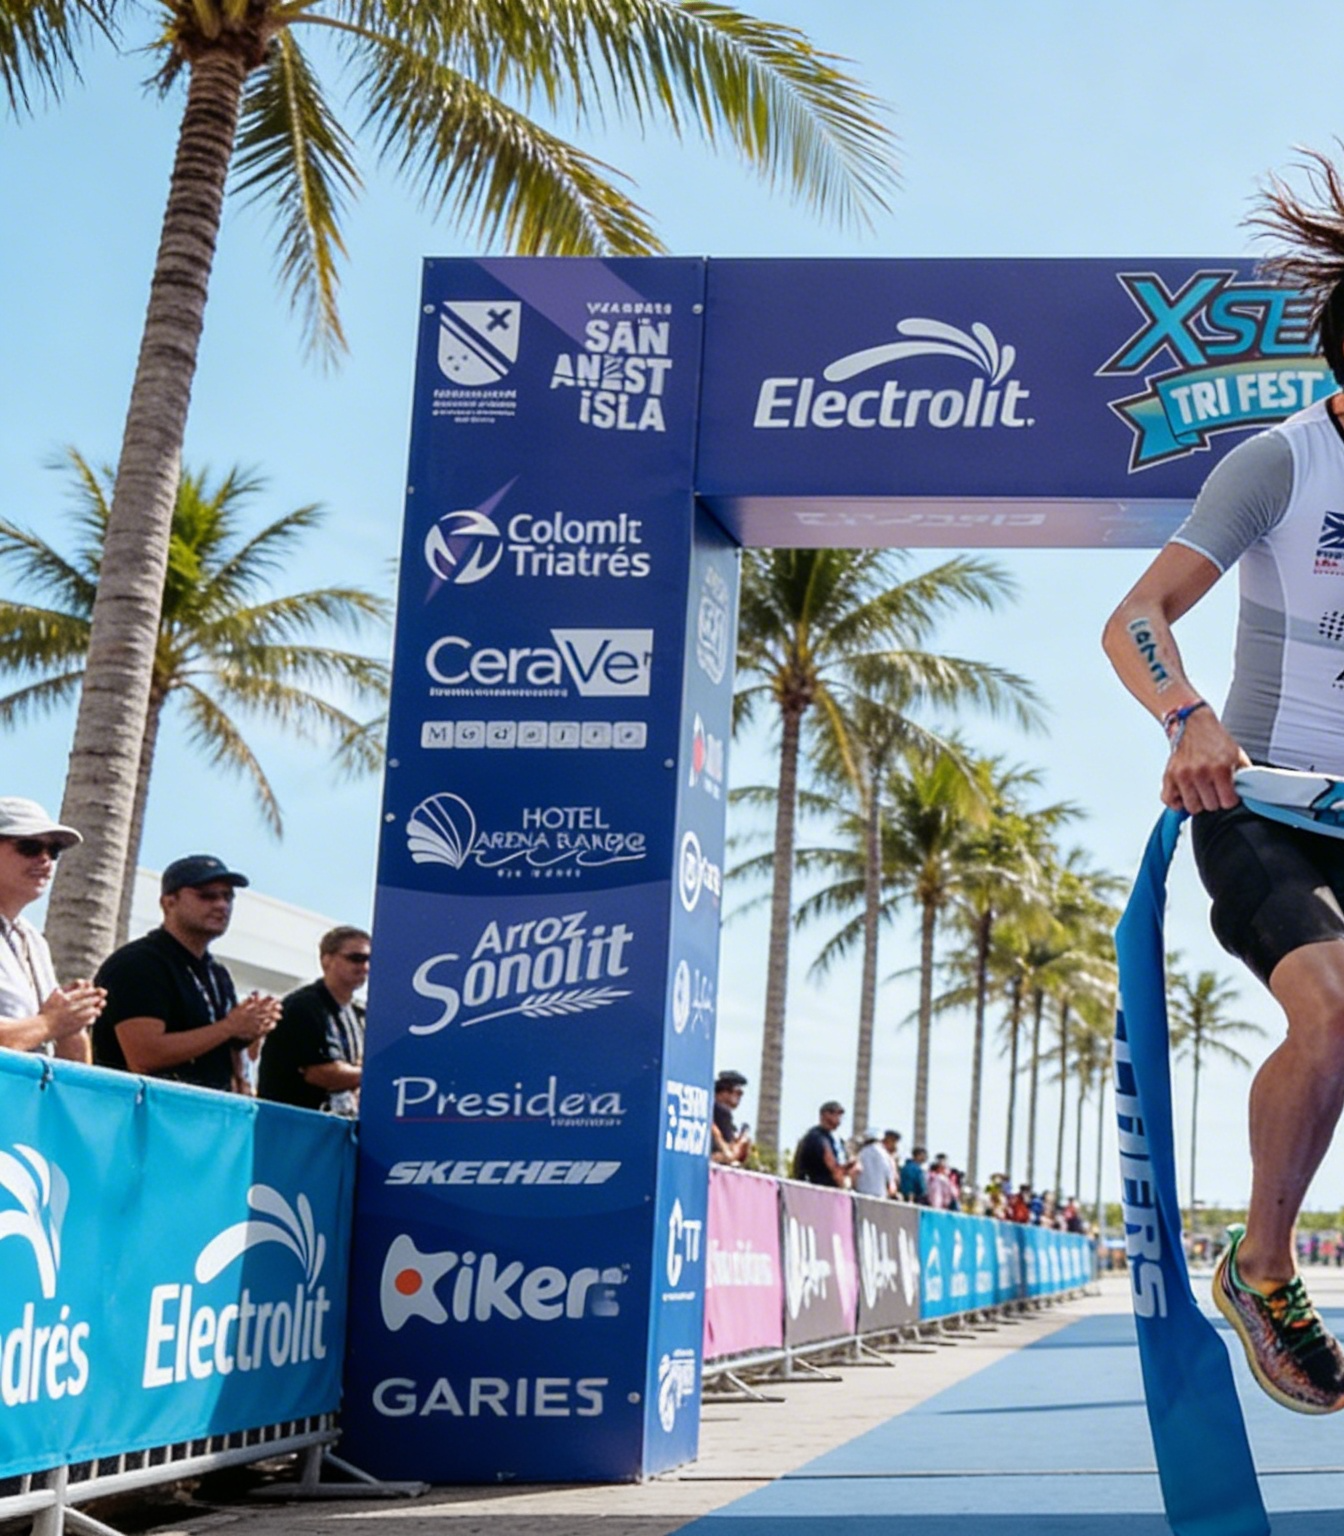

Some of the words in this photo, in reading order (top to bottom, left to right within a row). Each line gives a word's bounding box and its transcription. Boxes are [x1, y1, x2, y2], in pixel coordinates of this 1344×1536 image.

[1169, 378, 1231, 425] TRI
[1236, 371, 1325, 413] FEST
[508, 545, 650, 577] Triatrés
[523, 807, 610, 830] HOTEL
[471, 911, 588, 960] Arroz
[408, 924, 634, 1036] Sonolit
[0, 1302, 90, 1407] drés
[142, 1282, 331, 1389] Electrolit
[372, 1377, 609, 1417] GARIES
